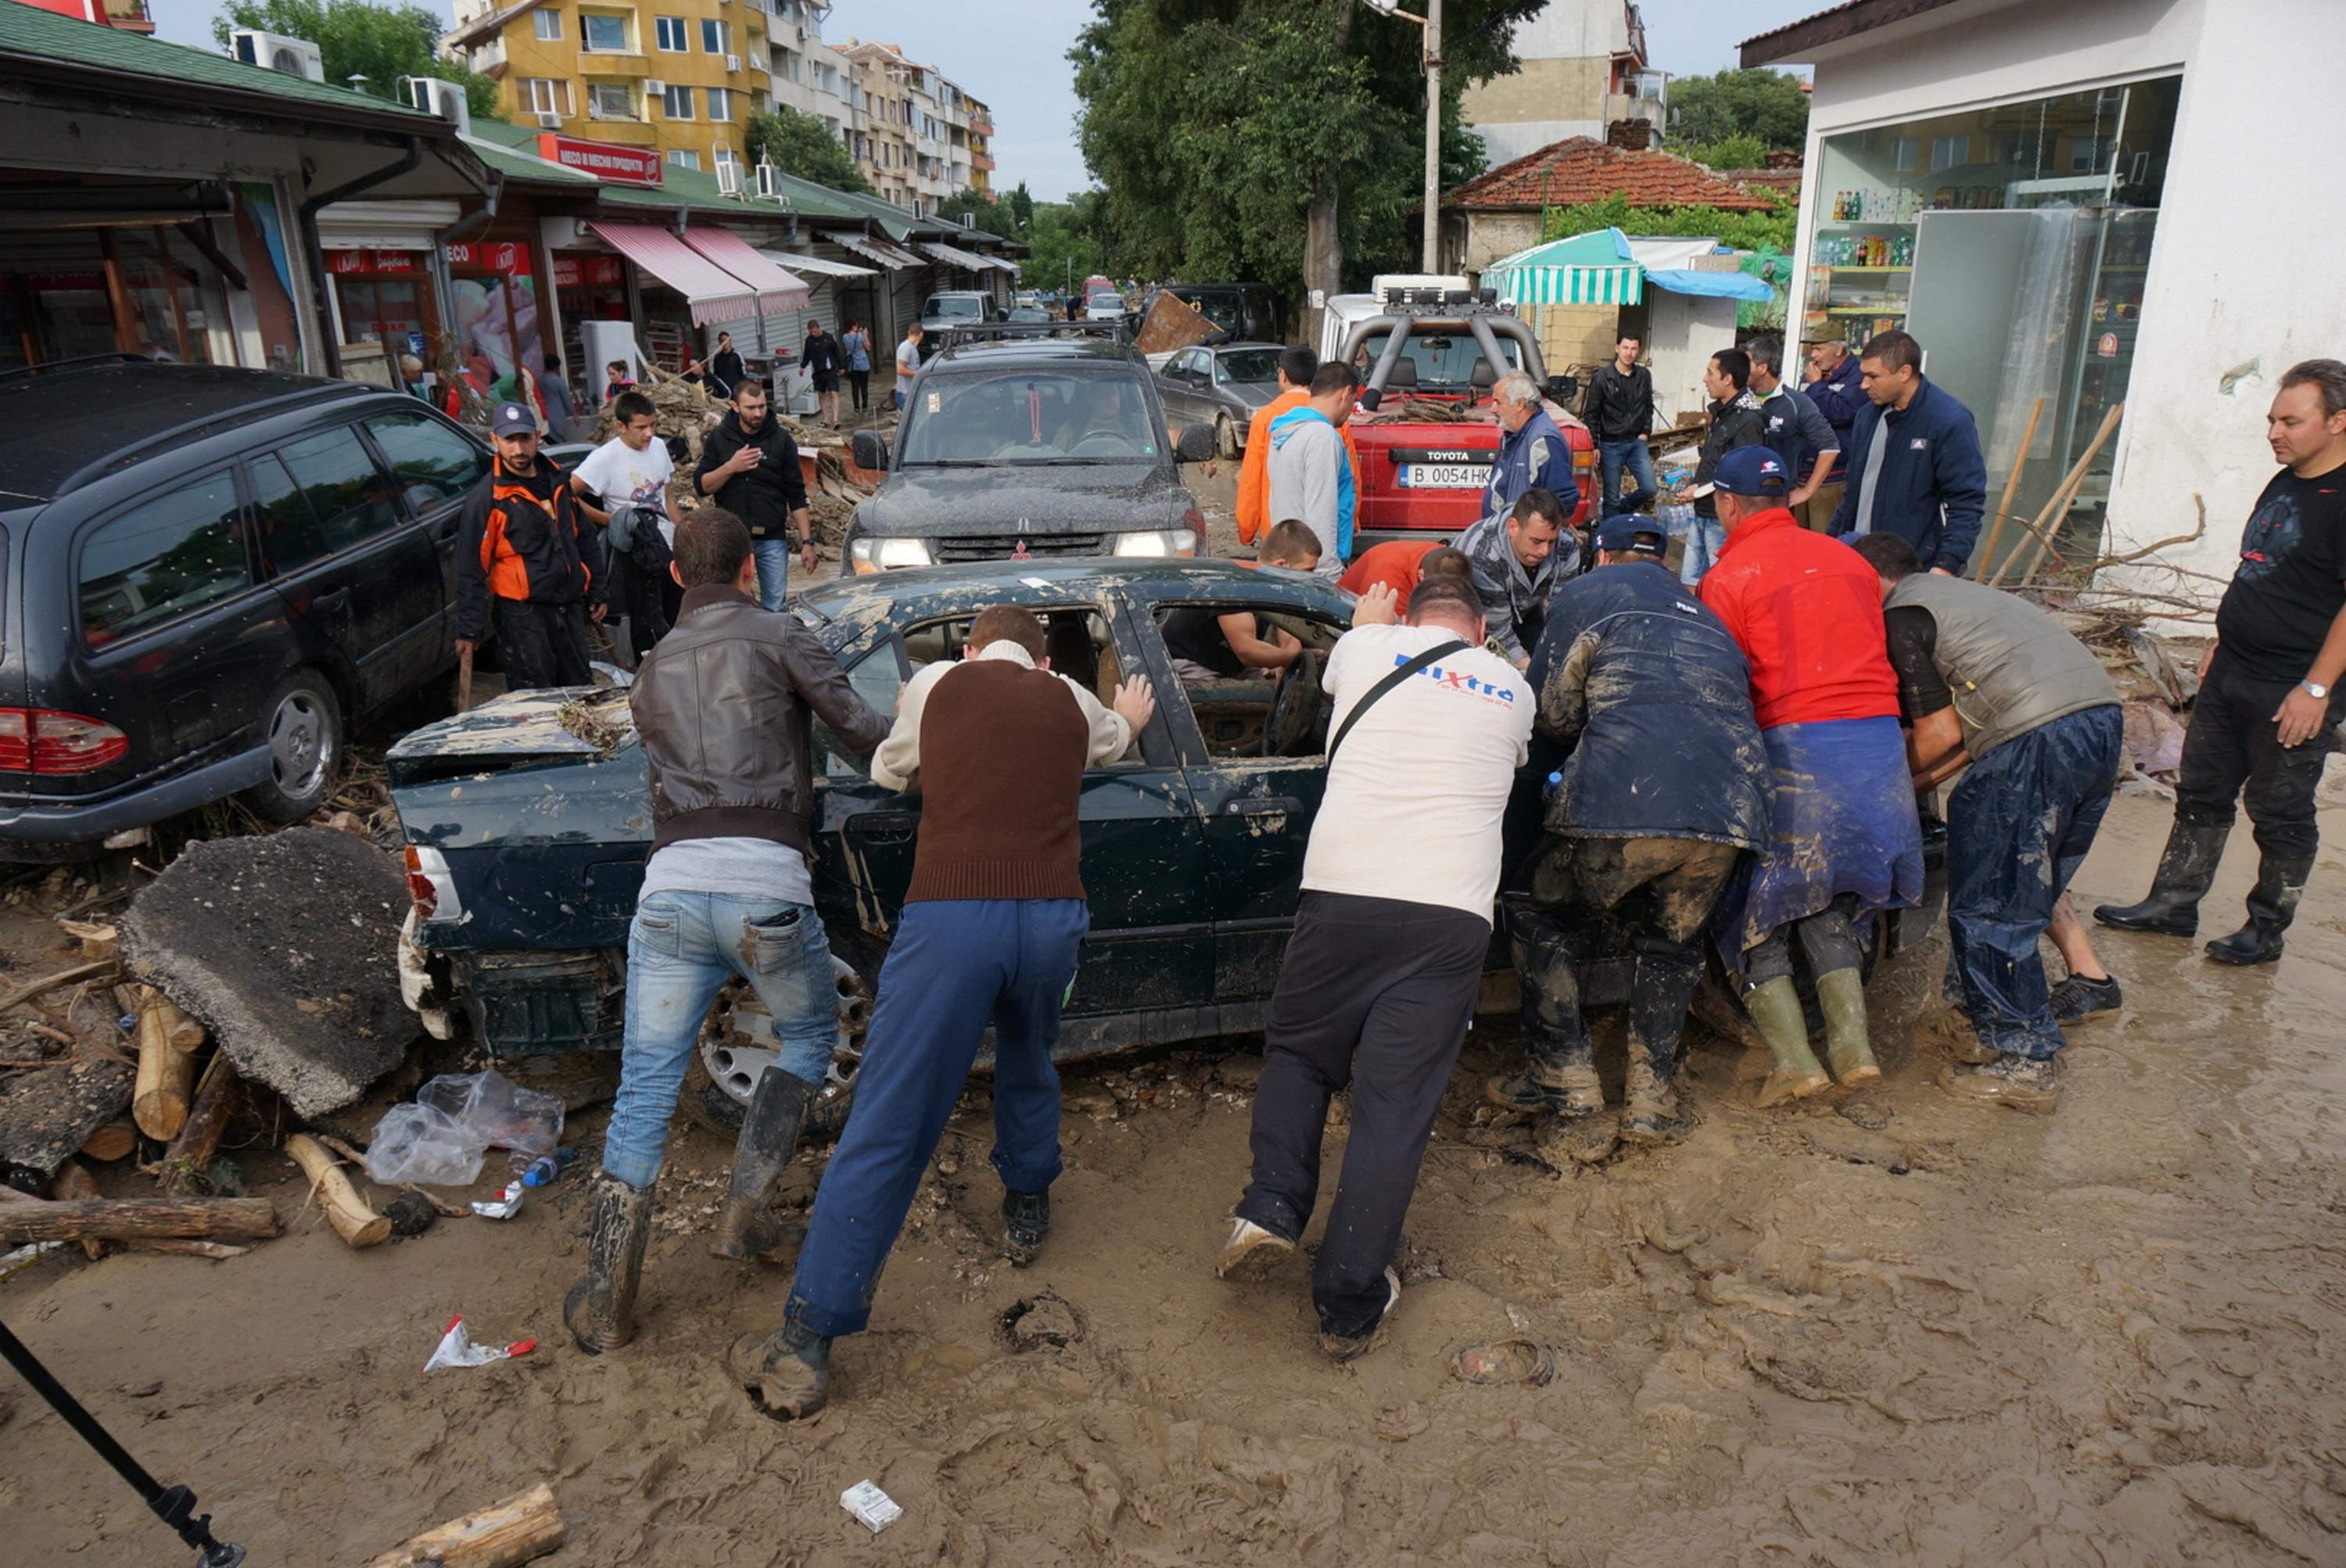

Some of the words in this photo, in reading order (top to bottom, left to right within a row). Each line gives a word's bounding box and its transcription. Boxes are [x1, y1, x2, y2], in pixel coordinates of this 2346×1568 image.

[560, 149, 582, 165] МЕСО
[1426, 451, 1469, 461] TOYOTA
[1415, 468, 1425, 483] B
[1433, 468, 1468, 483] 0054
[1471, 468, 1490, 483] HK
